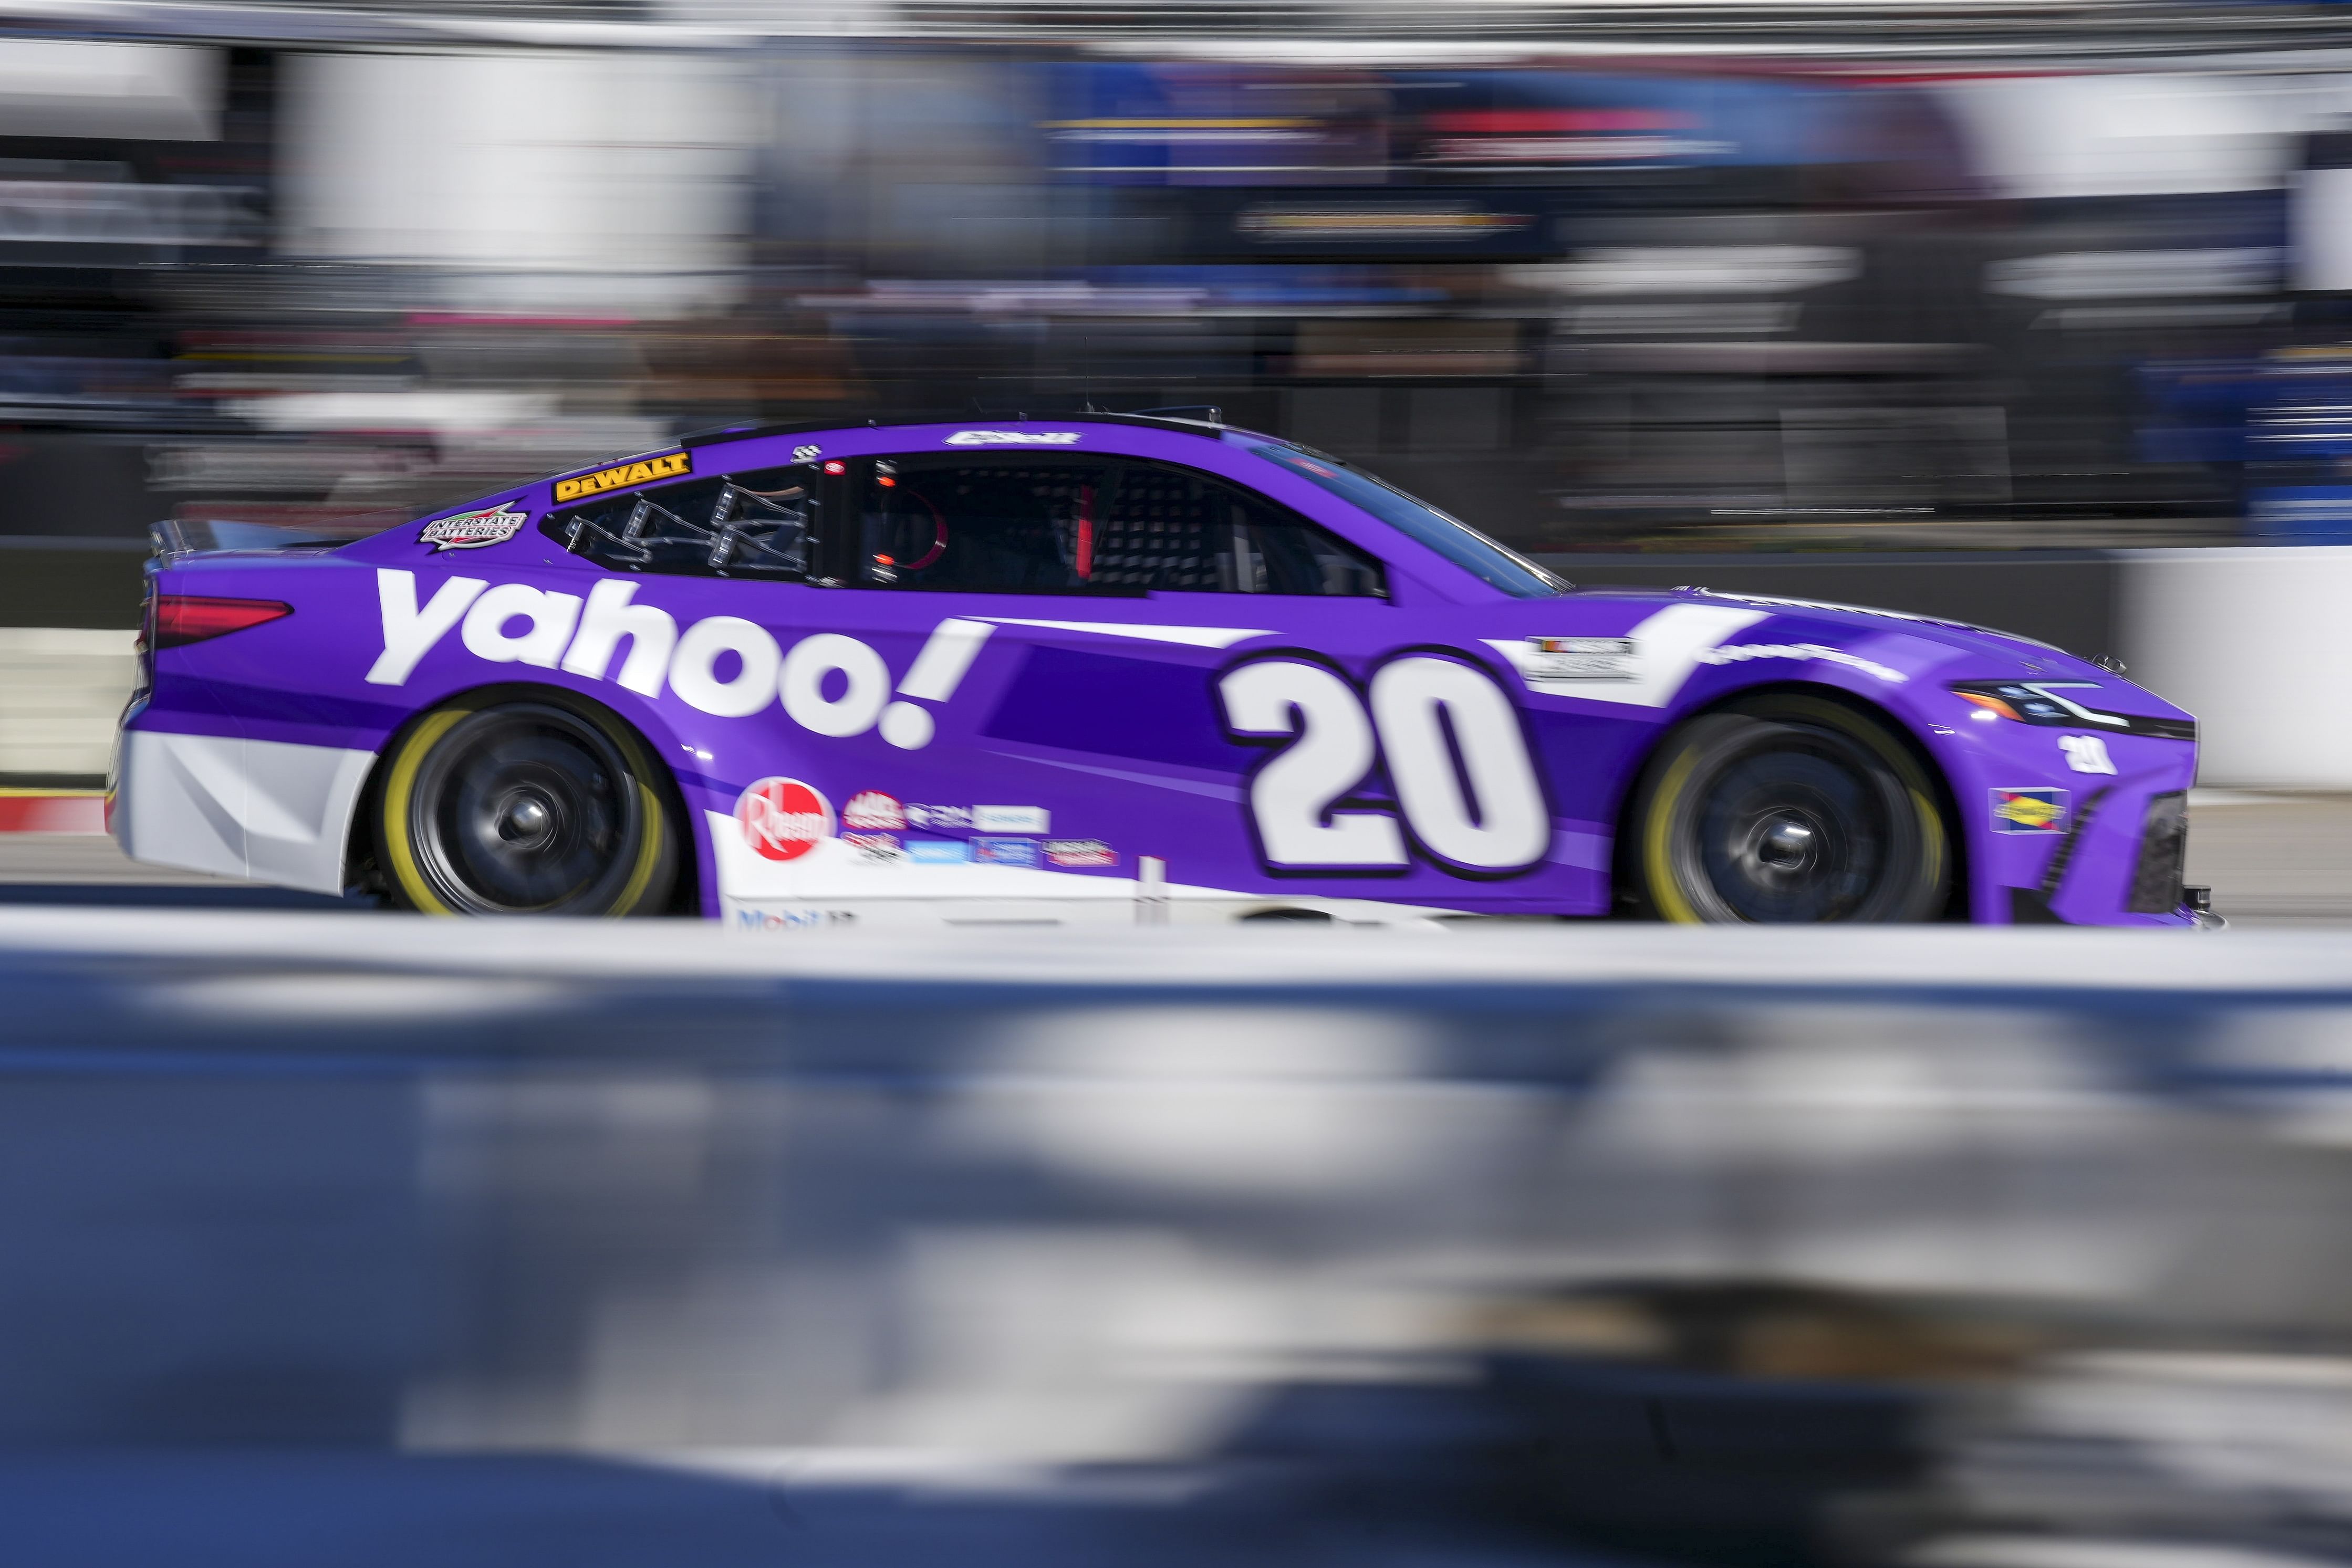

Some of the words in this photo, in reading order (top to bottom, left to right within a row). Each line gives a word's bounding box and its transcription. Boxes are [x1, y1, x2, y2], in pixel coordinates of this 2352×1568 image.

[558, 454, 690, 498] DEWALT
[428, 526, 508, 537] BATTERIES
[432, 516, 518, 529] INTERSTATE
[365, 568, 998, 751] yahoo!
[1216, 652, 1553, 874] 20
[746, 780, 827, 852] Rheem
[736, 910, 820, 933] Mobil
